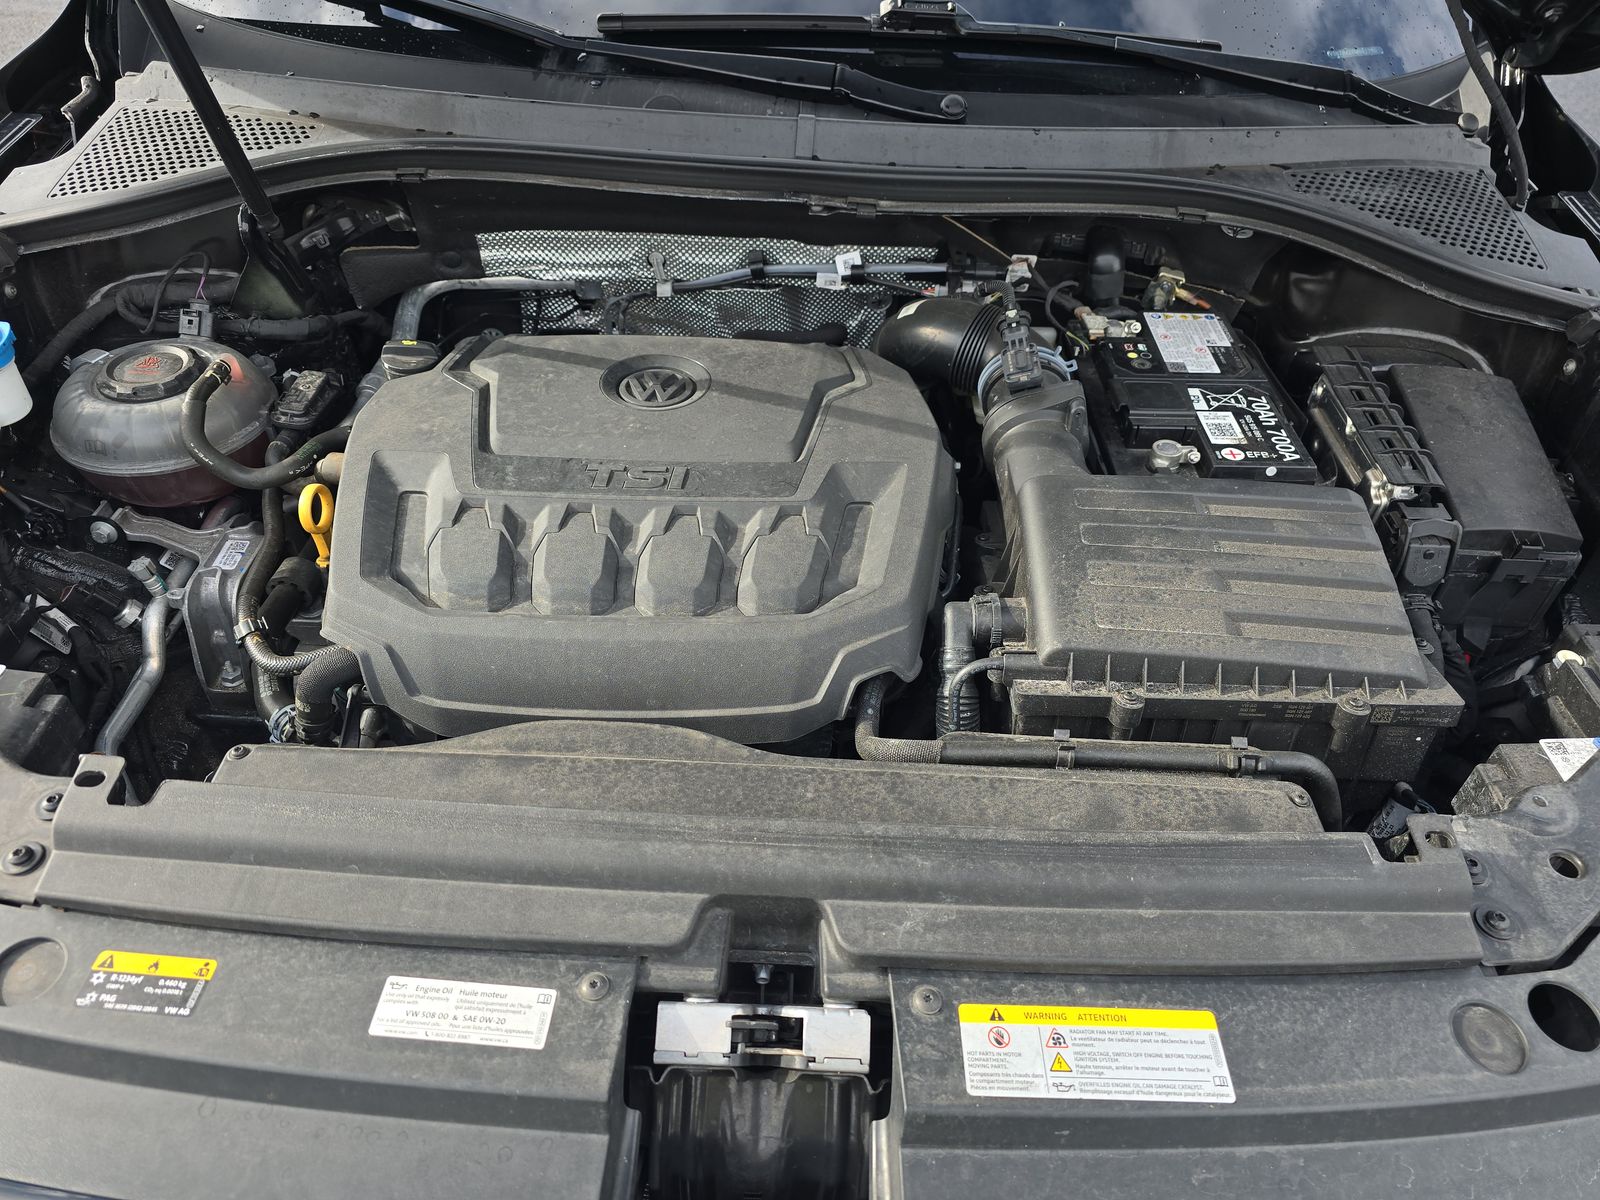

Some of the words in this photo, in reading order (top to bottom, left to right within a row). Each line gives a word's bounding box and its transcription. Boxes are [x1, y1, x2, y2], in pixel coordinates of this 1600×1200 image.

[1247, 395, 1279, 426] 70Ah
[1266, 428, 1301, 462] 700A
[1245, 450, 1278, 459] EFB+
[585, 463, 690, 490] TSI
[178, 980, 188, 989] kg
[415, 985, 441, 995] Engine
[441, 986, 454, 995] Oil
[459, 988, 479, 997] Huile
[480, 991, 508, 999] moteur
[99, 993, 117, 1002] PAG
[164, 1006, 178, 1015] VW
[178, 1007, 191, 1016] AG
[421, 1011, 437, 1019] 508
[437, 1012, 449, 1020] 00
[1024, 1012, 1067, 1021] WARNING
[1078, 1013, 1127, 1022] ATTENTION
